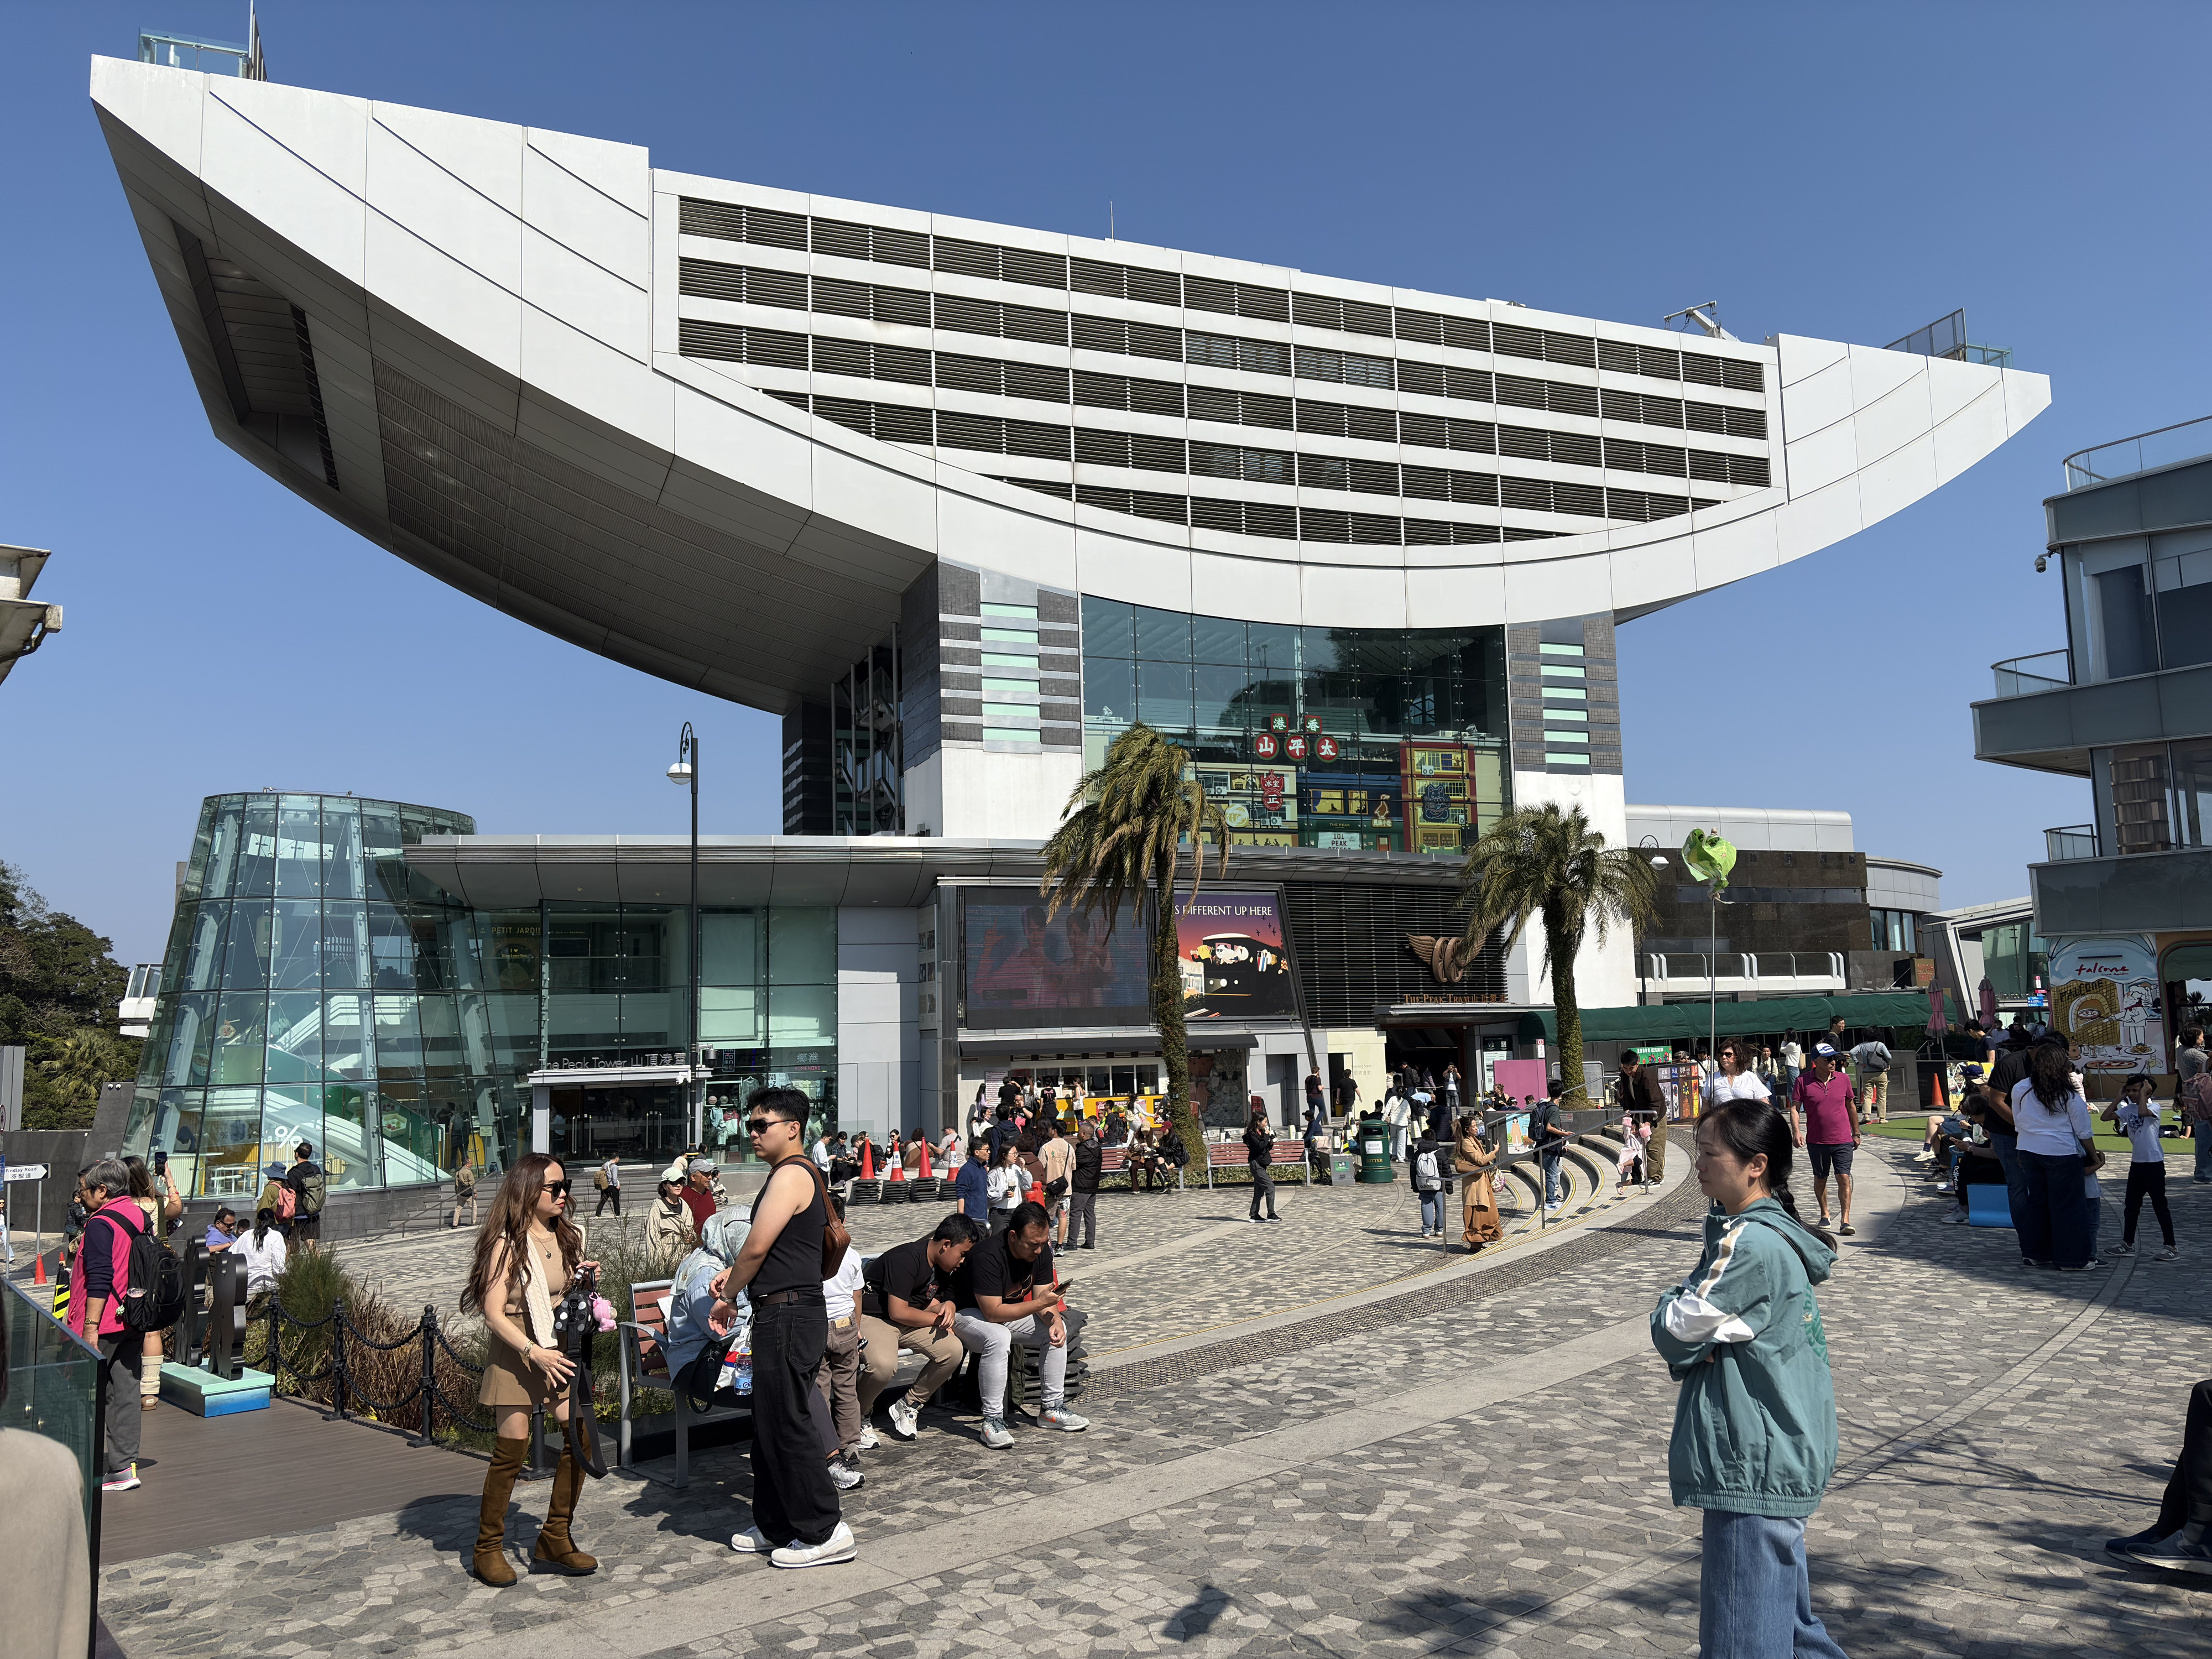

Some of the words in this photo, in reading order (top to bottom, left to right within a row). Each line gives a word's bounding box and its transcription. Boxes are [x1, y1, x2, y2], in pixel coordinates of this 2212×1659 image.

[1266, 794, 1280, 804] 正
[1234, 906, 1248, 916] UP
[1250, 906, 1272, 916] HERE
[562, 1057, 589, 1069] Peak
[592, 1057, 627, 1068] Tower
